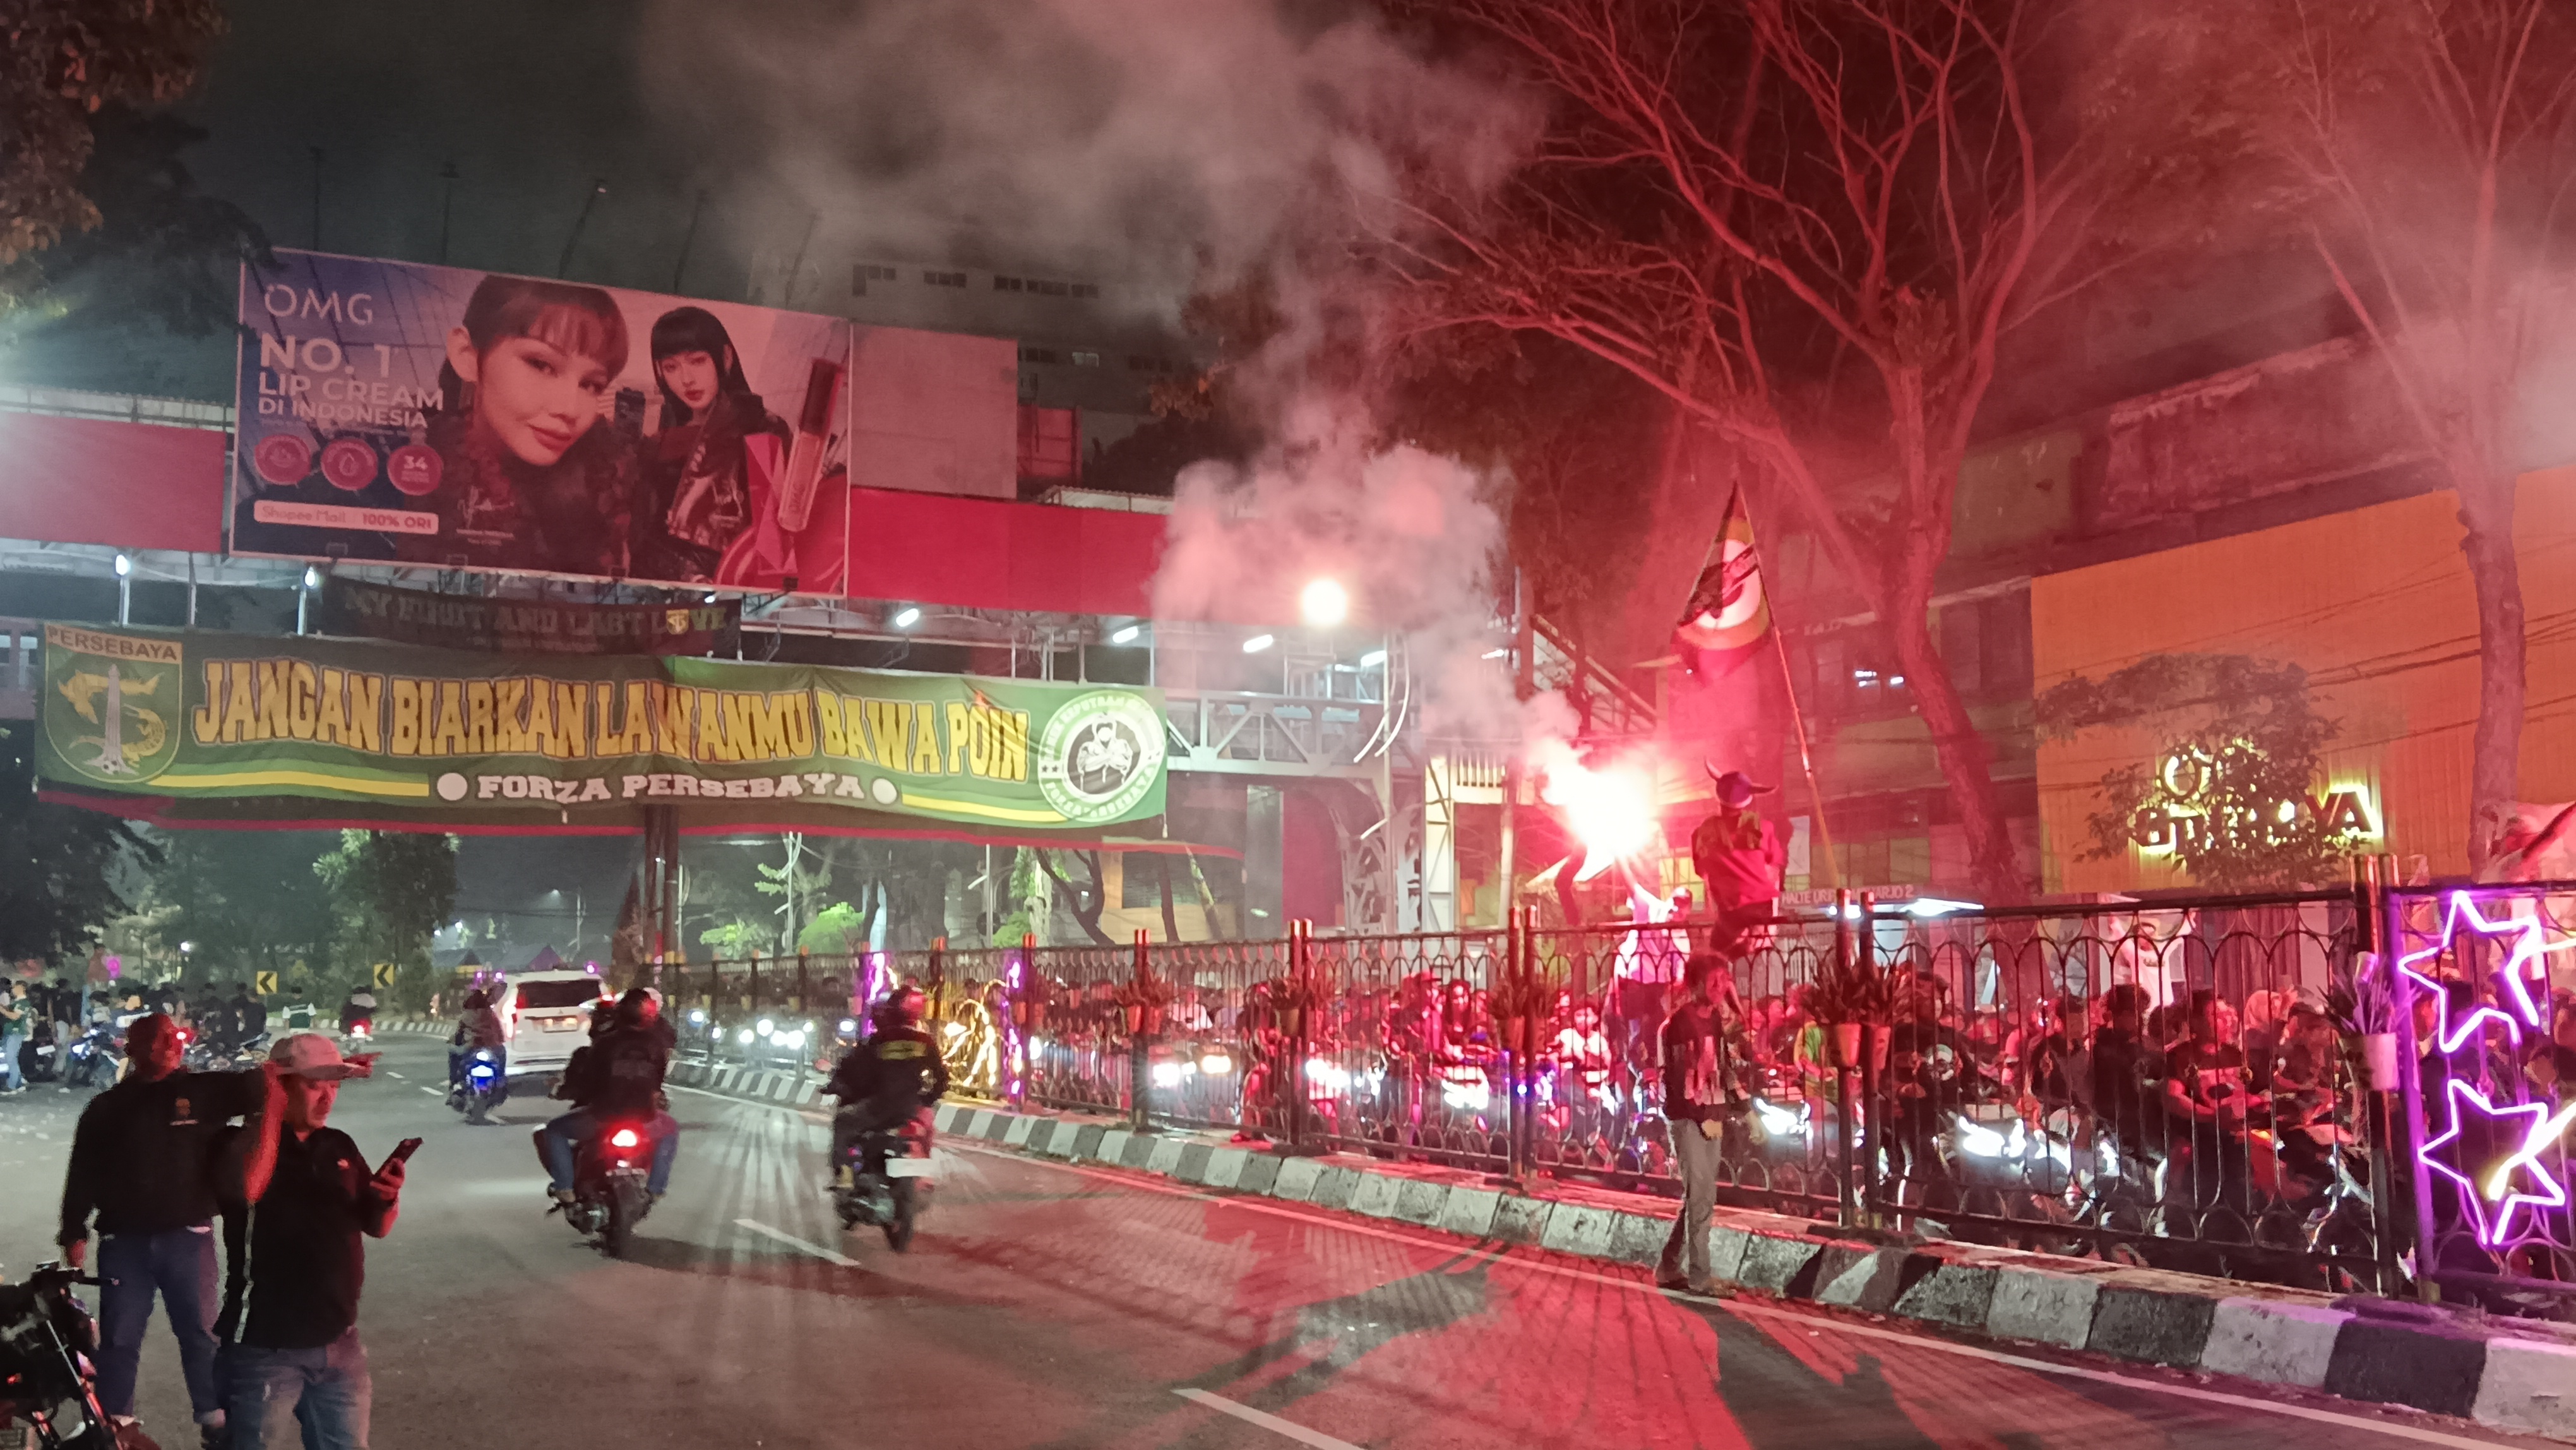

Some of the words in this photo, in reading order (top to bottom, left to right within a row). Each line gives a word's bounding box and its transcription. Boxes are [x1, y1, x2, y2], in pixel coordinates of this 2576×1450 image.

[264, 284, 374, 326] OMG
[259, 332, 355, 375] NO.
[373, 344, 391, 378] 1
[258, 371, 311, 397] LIP
[321, 378, 444, 411] CREAM
[258, 397, 283, 415] DI
[291, 400, 429, 428] INDONESIA
[403, 455, 429, 470] 34
[261, 505, 313, 522] Shopee
[316, 509, 347, 524] Mall
[362, 512, 400, 527] 100%
[403, 517, 432, 530] ORI
[494, 604, 558, 632] AND
[46, 625, 178, 661] PERSEBAYA
[193, 657, 385, 755] JANGAN
[390, 677, 589, 758] BIARKAN
[593, 678, 816, 763] LAWANMU
[815, 688, 943, 776] BAWA
[945, 699, 1030, 782] POIN
[477, 774, 612, 804] FORZA
[621, 773, 865, 800] PERSEBAYA
[1781, 891, 1811, 904] HALTE
[1905, 884, 1914, 898] 2
